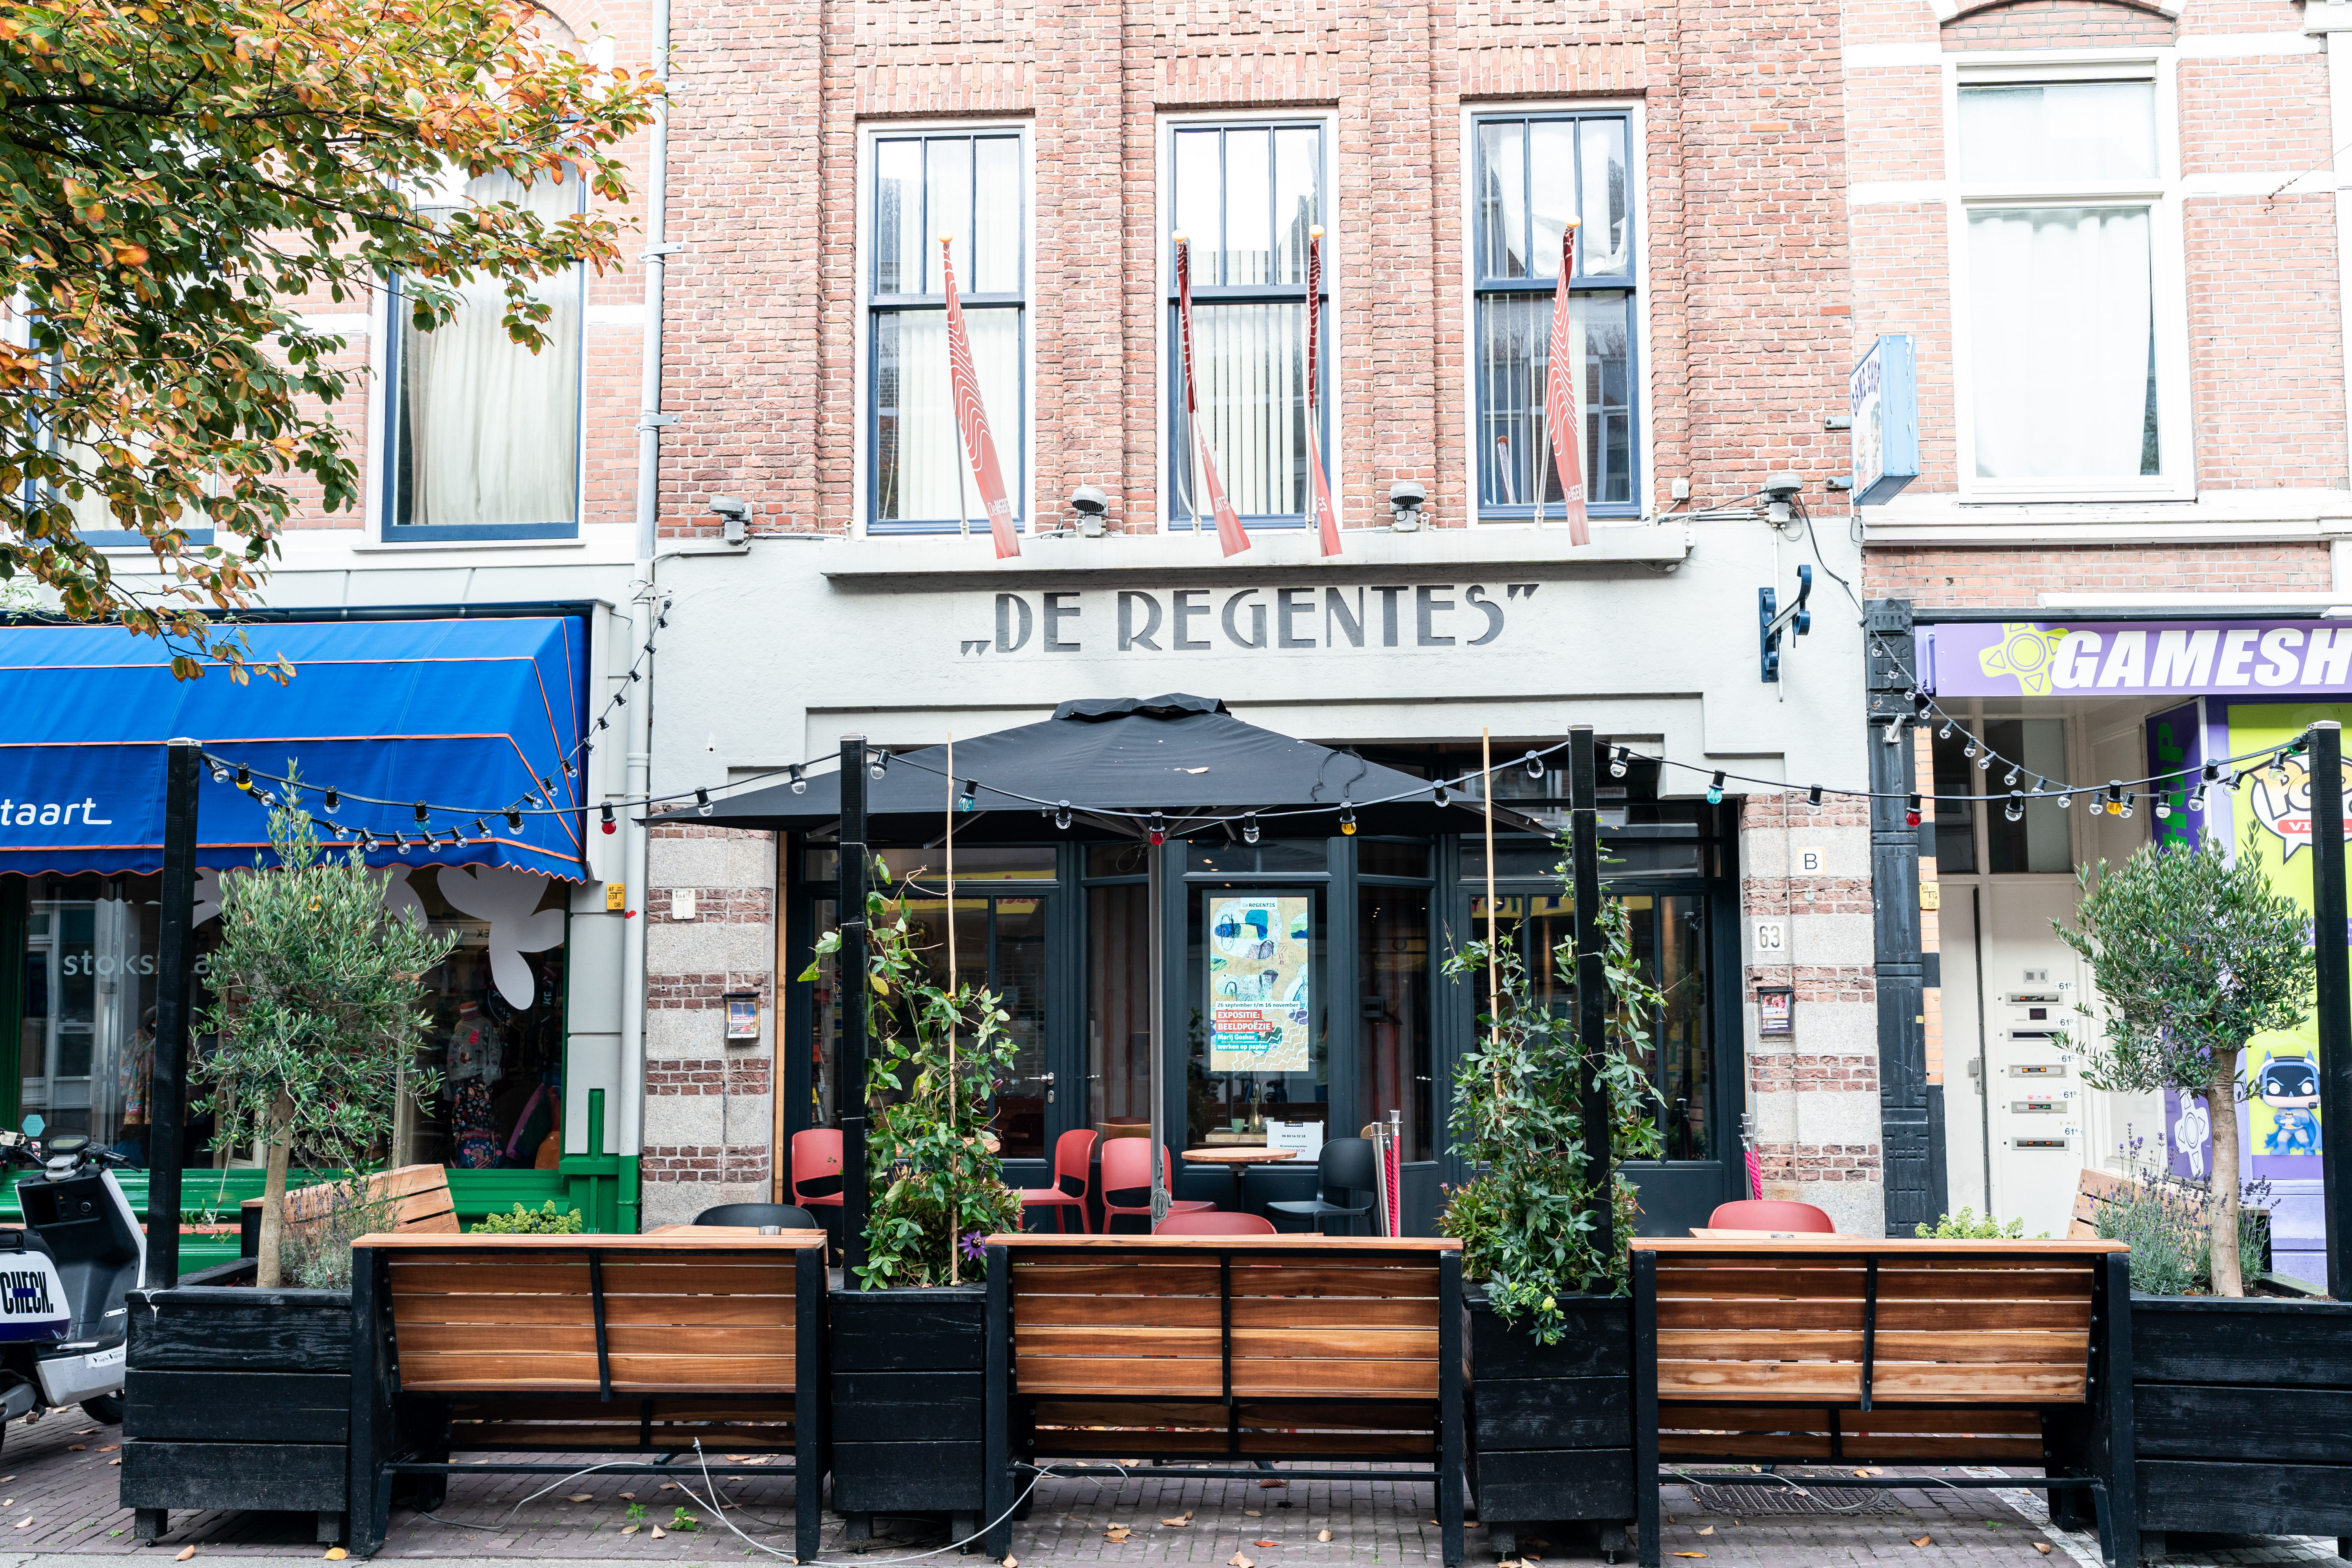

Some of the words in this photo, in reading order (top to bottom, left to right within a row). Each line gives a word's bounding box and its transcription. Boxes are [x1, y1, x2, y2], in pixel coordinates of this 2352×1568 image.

[1852, 367, 1866, 417] GAME
[1867, 360, 1880, 394] SHOP
[2158, 722, 2187, 848] HOP
[0, 798, 112, 826] taart
[1804, 853, 1817, 869] B
[1759, 926, 1780, 948] 63
[1218, 1022, 1271, 1030] BEELDPOËZIE
